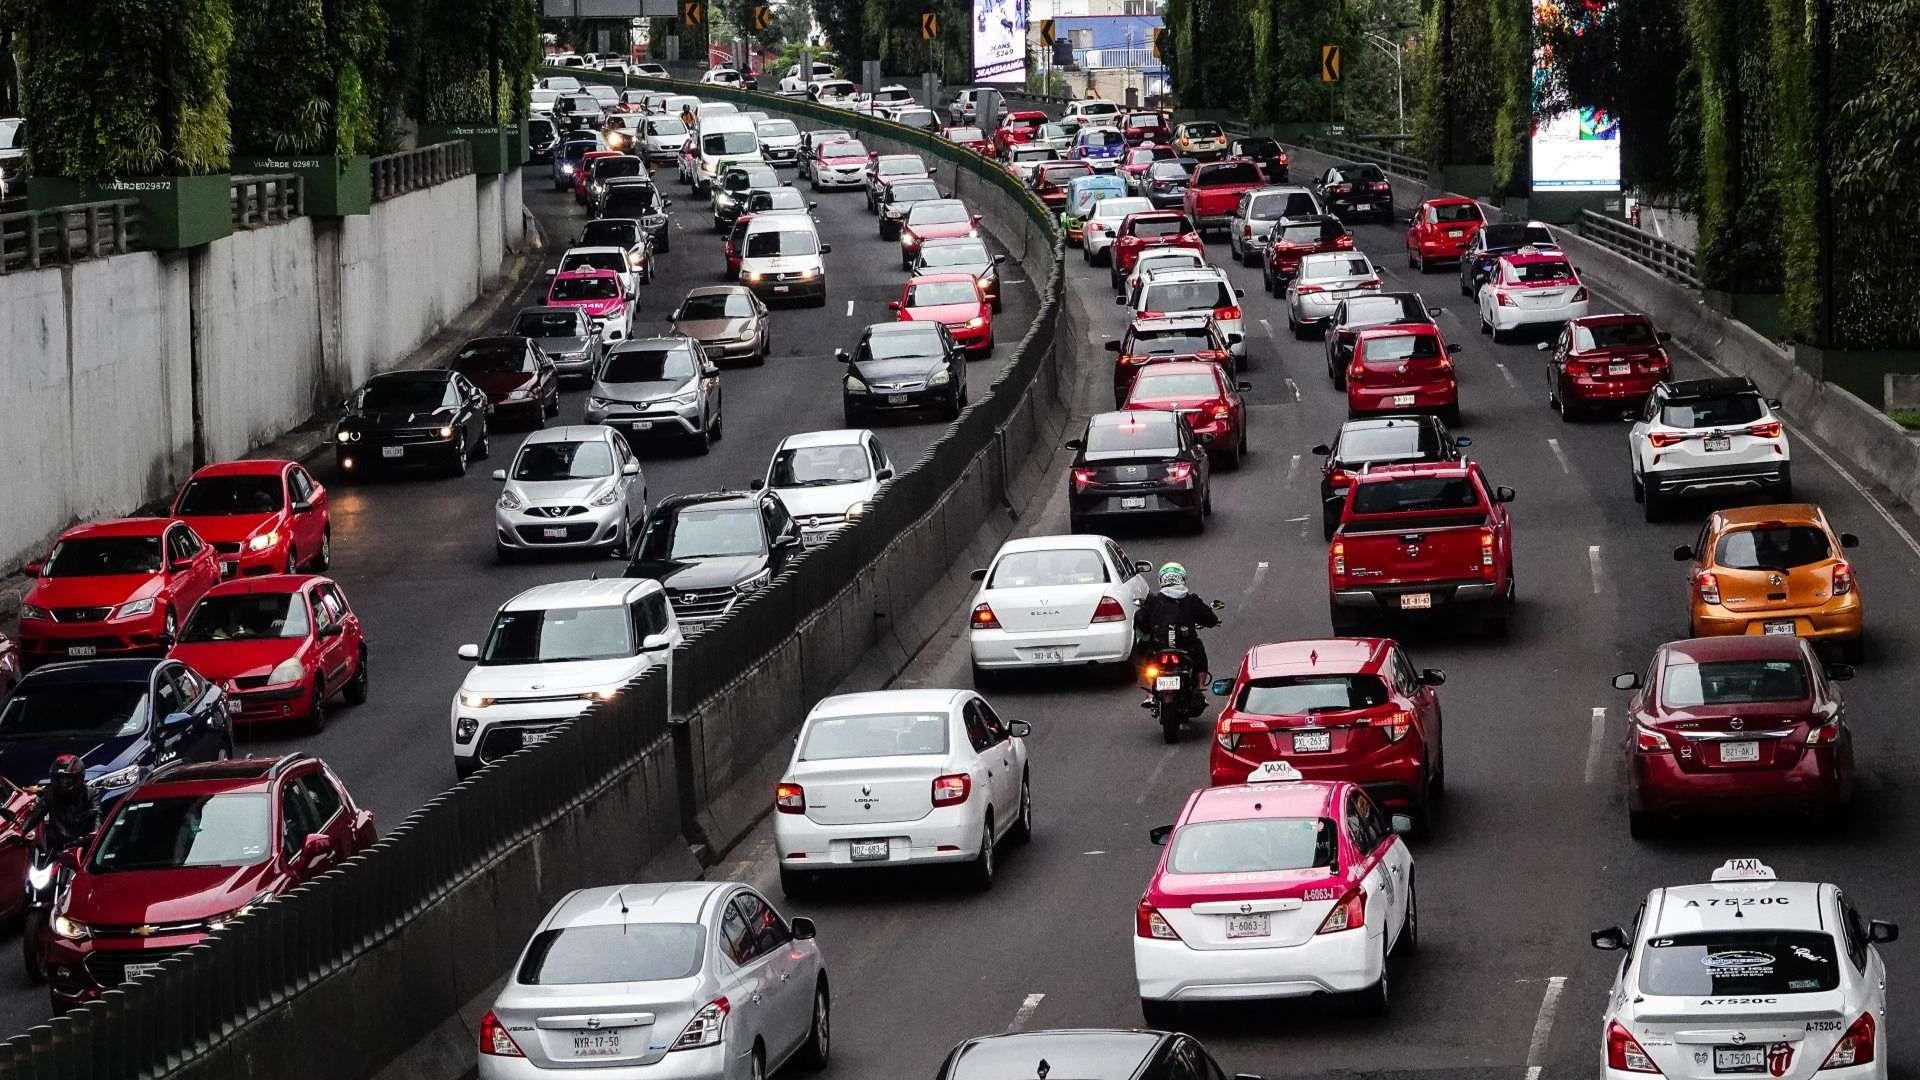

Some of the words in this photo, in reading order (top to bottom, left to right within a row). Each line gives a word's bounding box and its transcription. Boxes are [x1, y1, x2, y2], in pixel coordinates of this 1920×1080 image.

[1263, 763, 1286, 773] TAXI
[1729, 859, 1757, 870] TAXI
[1303, 887, 1334, 900] A-6063-J
[1700, 998, 1777, 1006] A7520C
[1805, 1020, 1842, 1032] A-7520-C
[574, 1036, 620, 1049] NYR-17-50
[1717, 1051, 1763, 1065] A-7520-C
